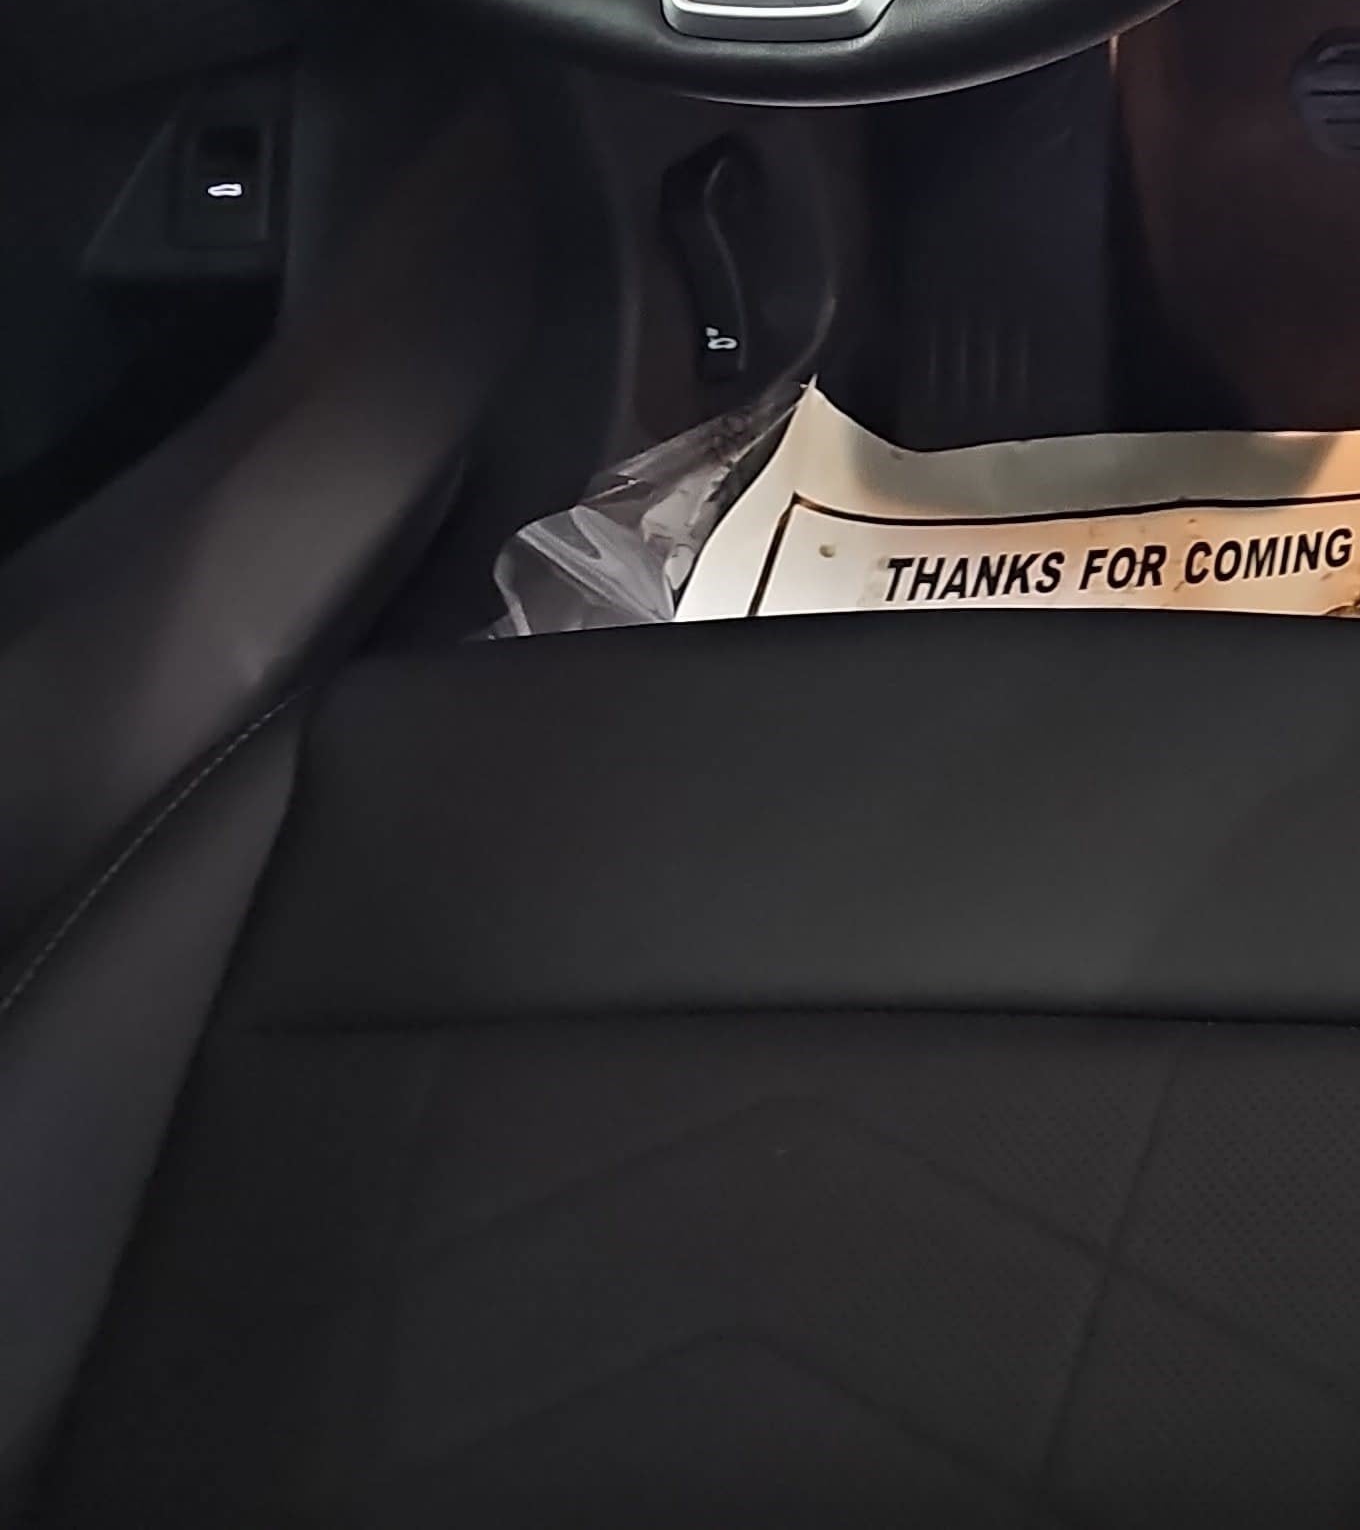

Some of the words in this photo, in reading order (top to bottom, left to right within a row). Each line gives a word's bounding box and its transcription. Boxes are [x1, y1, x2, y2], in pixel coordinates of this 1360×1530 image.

[884, 551, 1065, 602] THANKS
[1078, 545, 1168, 591] FOR
[1184, 527, 1353, 585] COMING
